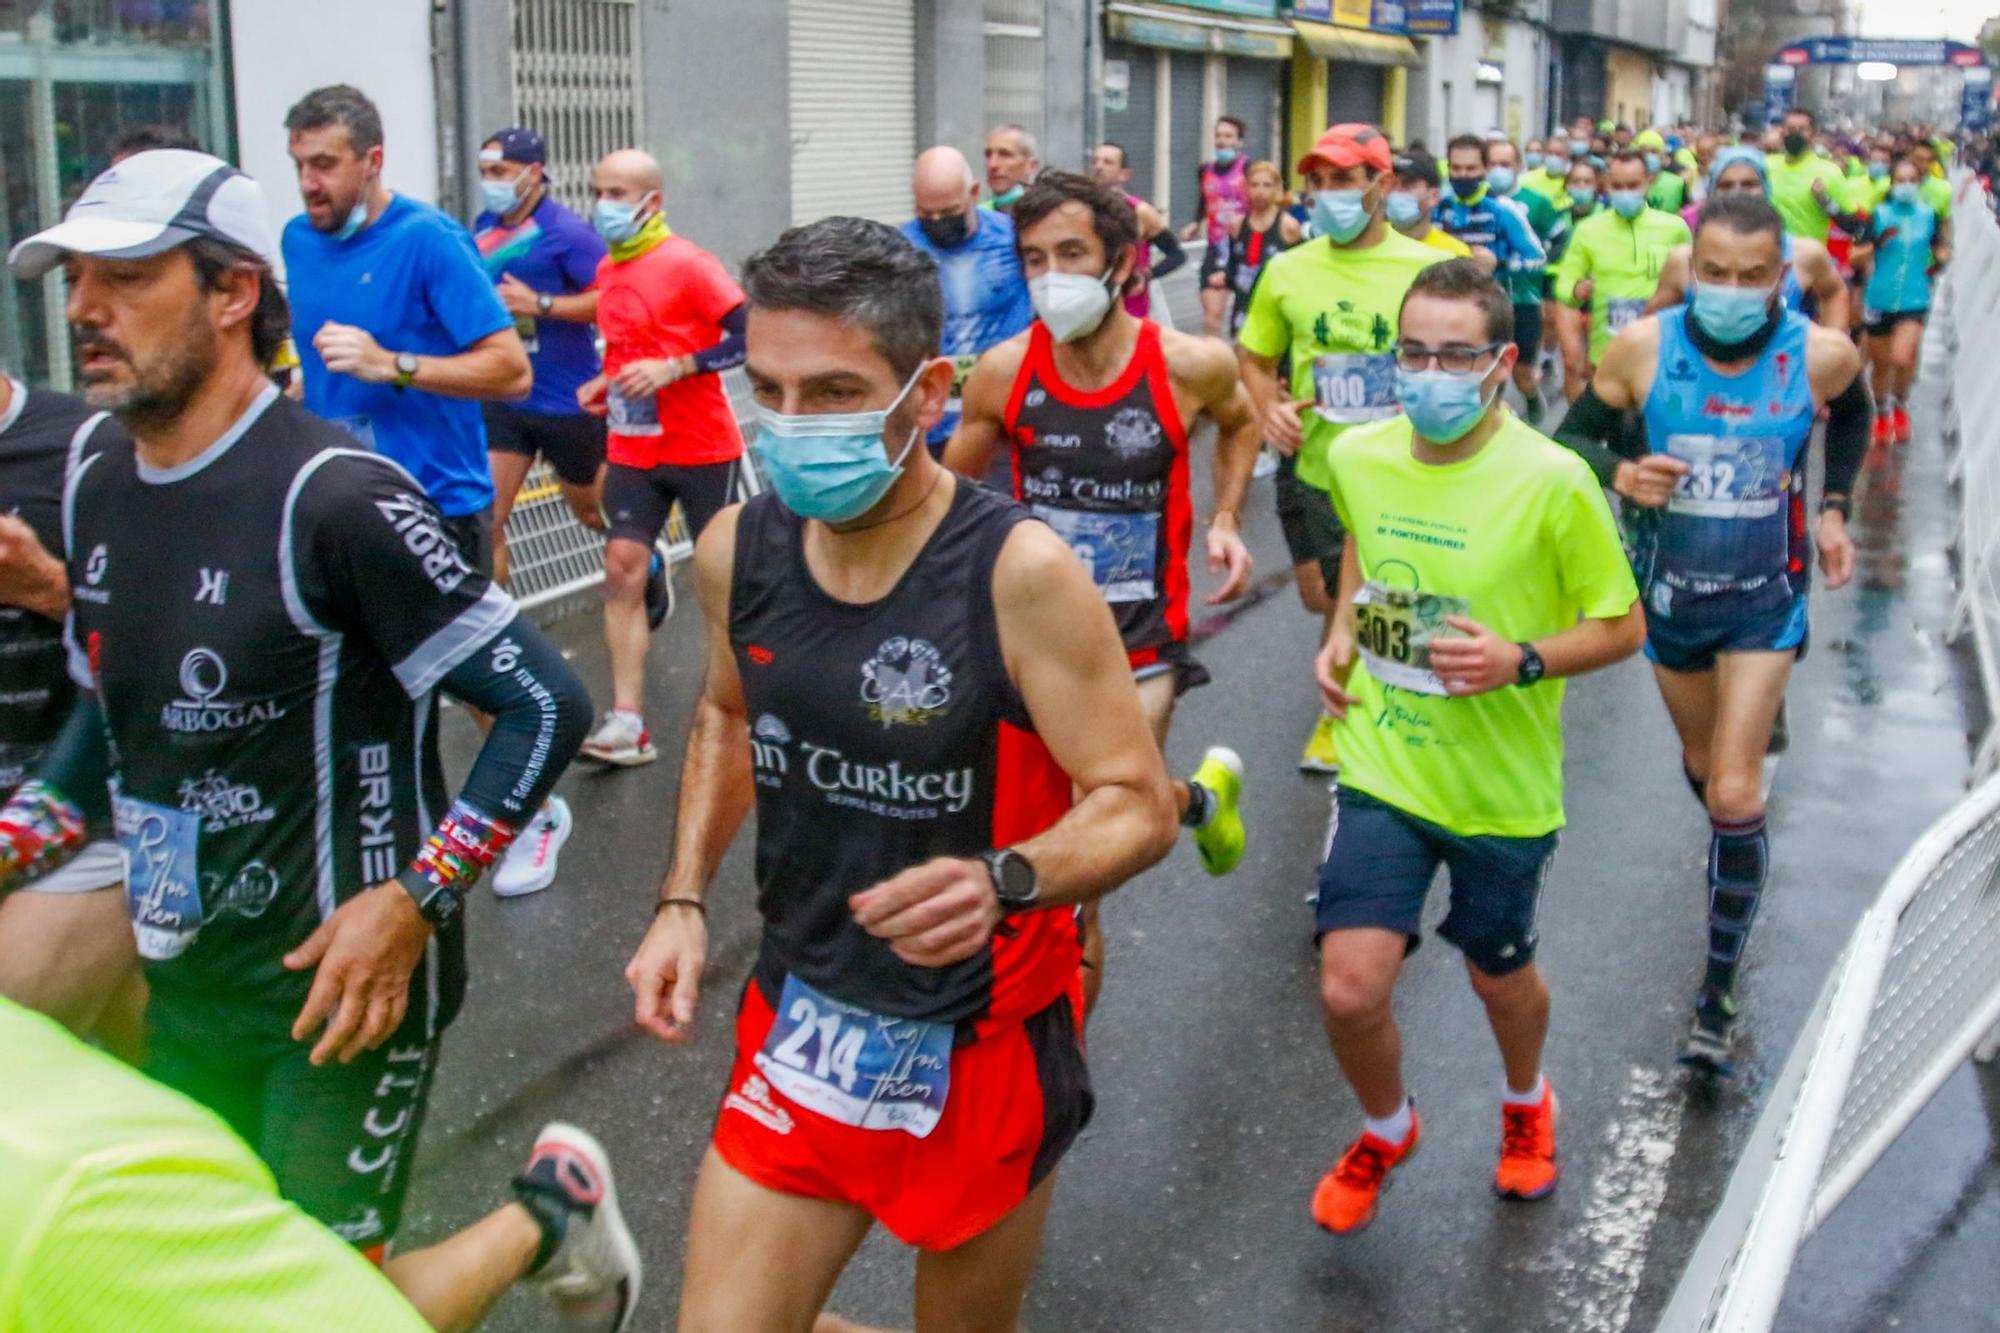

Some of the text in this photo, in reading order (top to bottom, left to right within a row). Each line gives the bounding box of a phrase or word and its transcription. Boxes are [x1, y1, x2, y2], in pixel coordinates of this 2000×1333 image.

[1317, 373, 1365, 407] 100
[800, 740, 973, 813] Turkey
[773, 997, 867, 1093] 214
